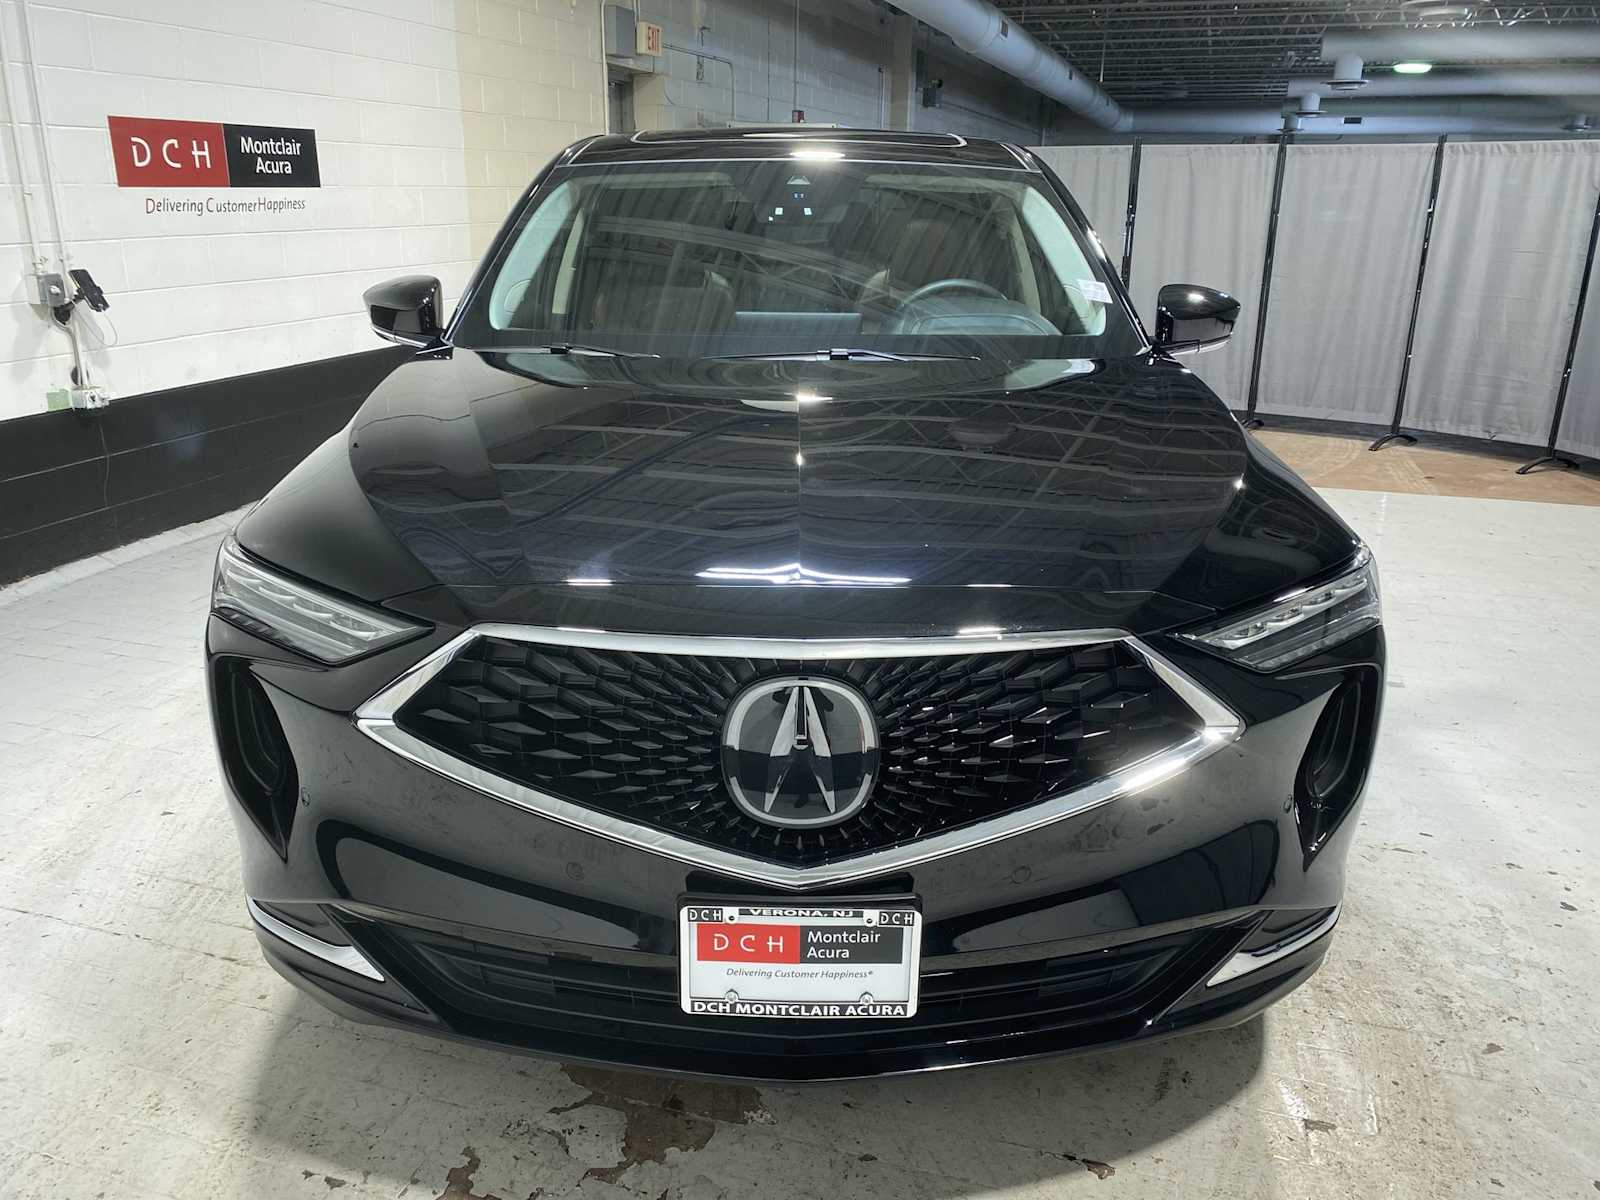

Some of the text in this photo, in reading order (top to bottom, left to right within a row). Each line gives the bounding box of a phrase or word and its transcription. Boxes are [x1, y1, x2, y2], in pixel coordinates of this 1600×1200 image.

[647, 26, 660, 53] EXIT
[240, 136, 301, 155] Montclair
[255, 157, 292, 174] Acura
[145, 198, 204, 216] Delivering
[689, 909, 722, 921] DCH
[832, 910, 854, 918] NJ
[880, 912, 913, 925] DCH
[713, 933, 784, 953] DCH
[807, 930, 881, 943] Montclair
[806, 946, 850, 959] Acura
[726, 968, 773, 979] Delivering
[774, 969, 819, 979] Customer
[693, 1002, 905, 1016] DCH MONTCLAIR ACURA
